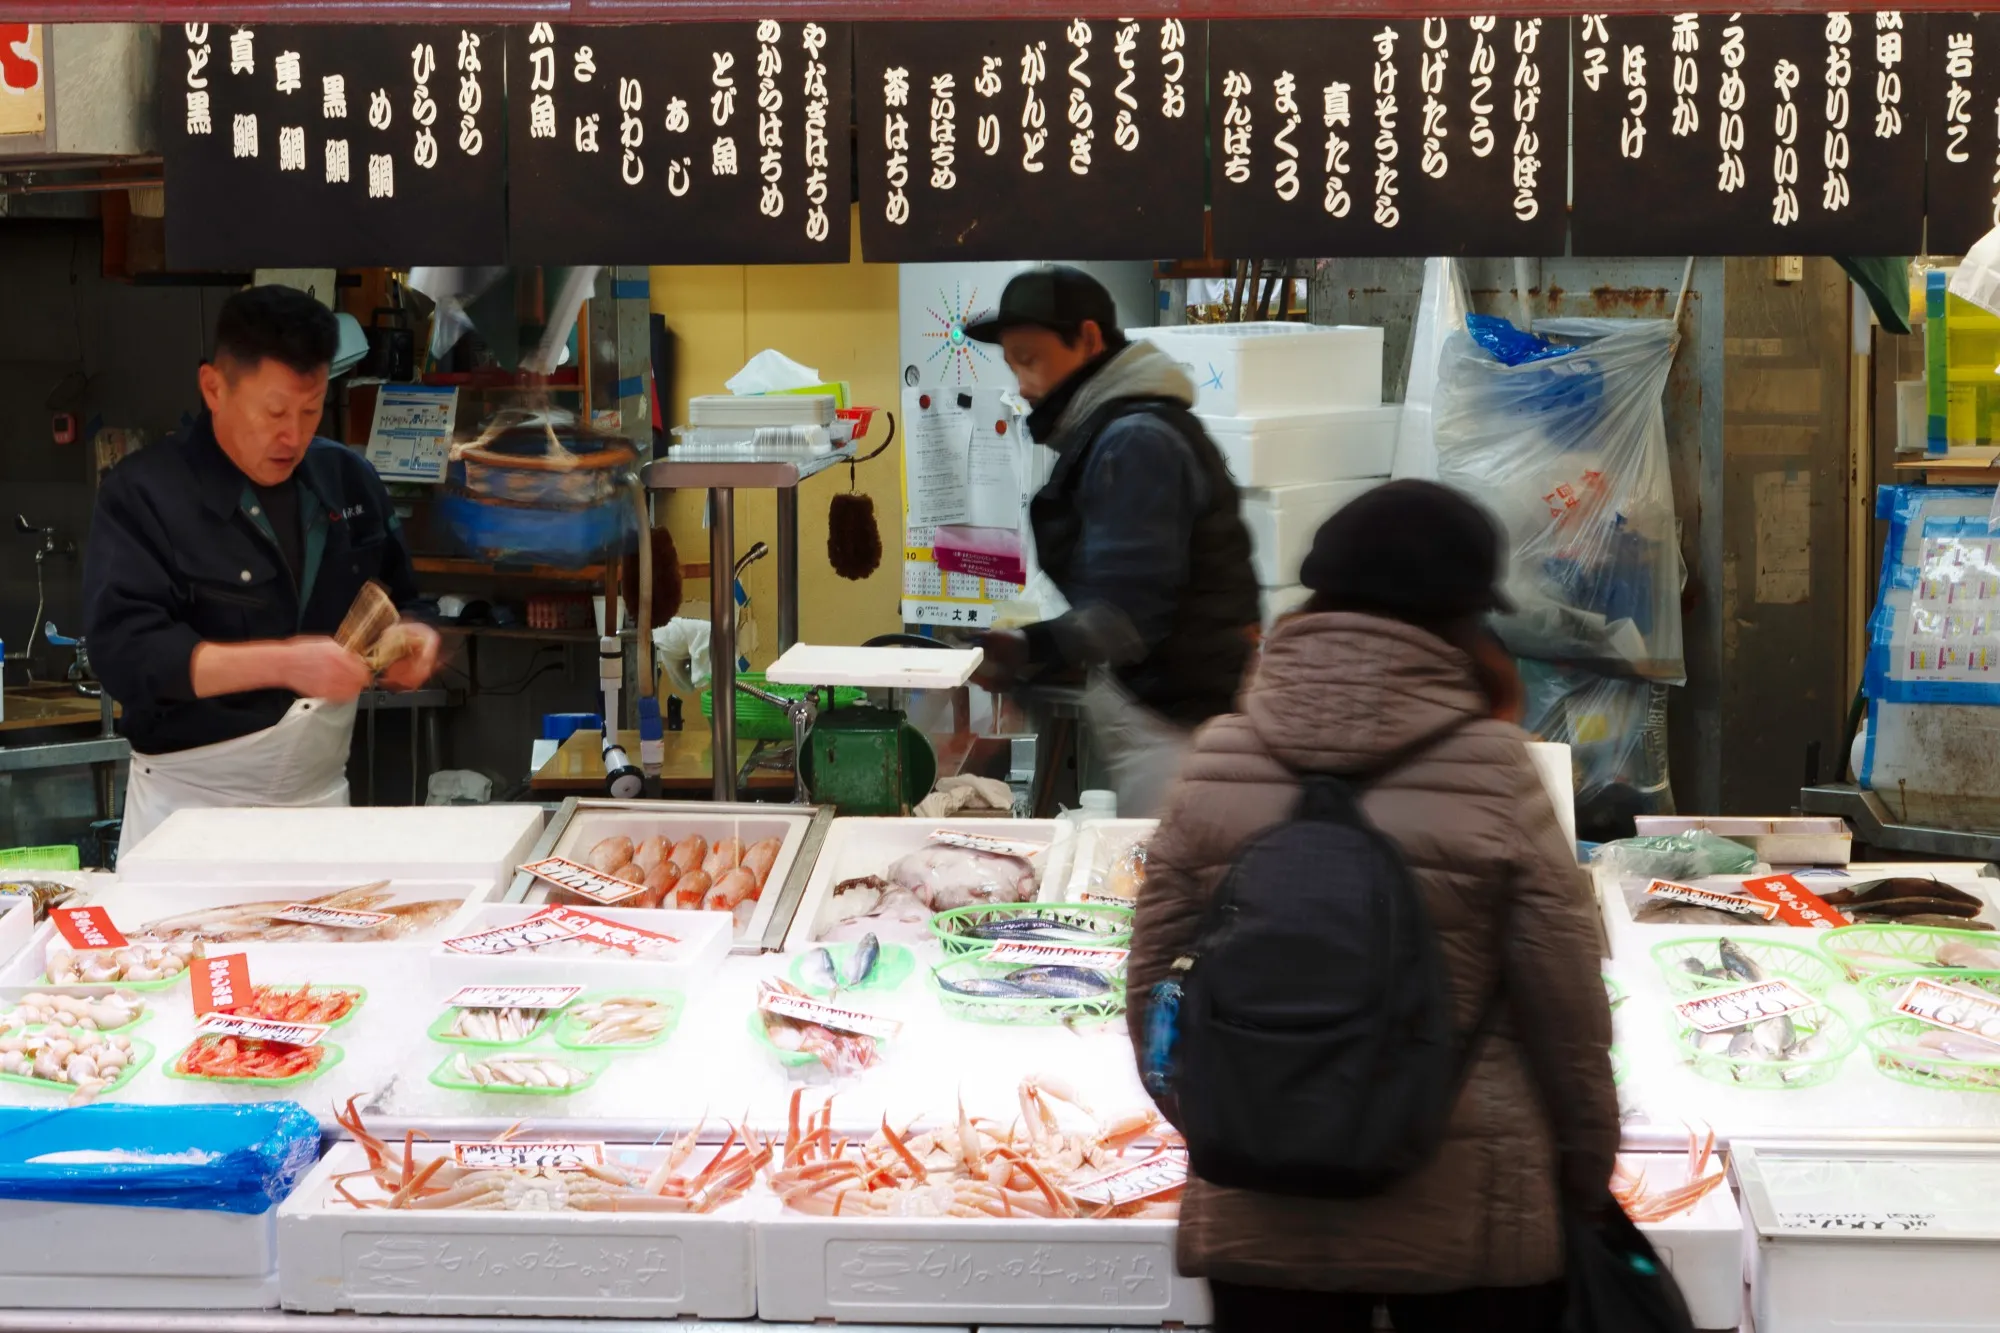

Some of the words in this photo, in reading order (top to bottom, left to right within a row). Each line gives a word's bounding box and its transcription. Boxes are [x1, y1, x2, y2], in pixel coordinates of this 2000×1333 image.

[230, 28, 259, 158] 真鯛
[276, 50, 306, 171] 車鯛
[322, 74, 350, 184] 黒鯛
[411, 43, 438, 169] ひらめ
[458, 30, 483, 156] なめら
[574, 46, 600, 153] さば
[711, 52, 738, 176] とび魚
[974, 56, 1002, 156] ぶり
[1021, 40, 1049, 173] がんど
[1113, 17, 1141, 152] ぞくら
[1161, 18, 1186, 118] かつお
[1223, 70, 1253, 184] かんぱち
[1373, 26, 1401, 229] すけそうたら
[1513, 17, 1542, 222] げんげんぼう
[1621, 44, 1648, 159] ほっけ
[1672, 13, 1701, 137] 赤いか
[1718, 12, 1746, 193] るめいか
[1823, 11, 1853, 212] あおりいか
[1946, 33, 1974, 163] 岩たこ
[368, 88, 394, 199] め鯛
[620, 77, 644, 186] いわし
[665, 96, 691, 197] あじ
[803, 22, 830, 242] やなぎはちめ
[883, 66, 910, 225] 茶はちめ
[930, 73, 957, 190] そいはちめ
[1273, 71, 1302, 202] まぐろ
[1323, 81, 1352, 218] 真たら
[1773, 58, 1801, 227] やりいか
